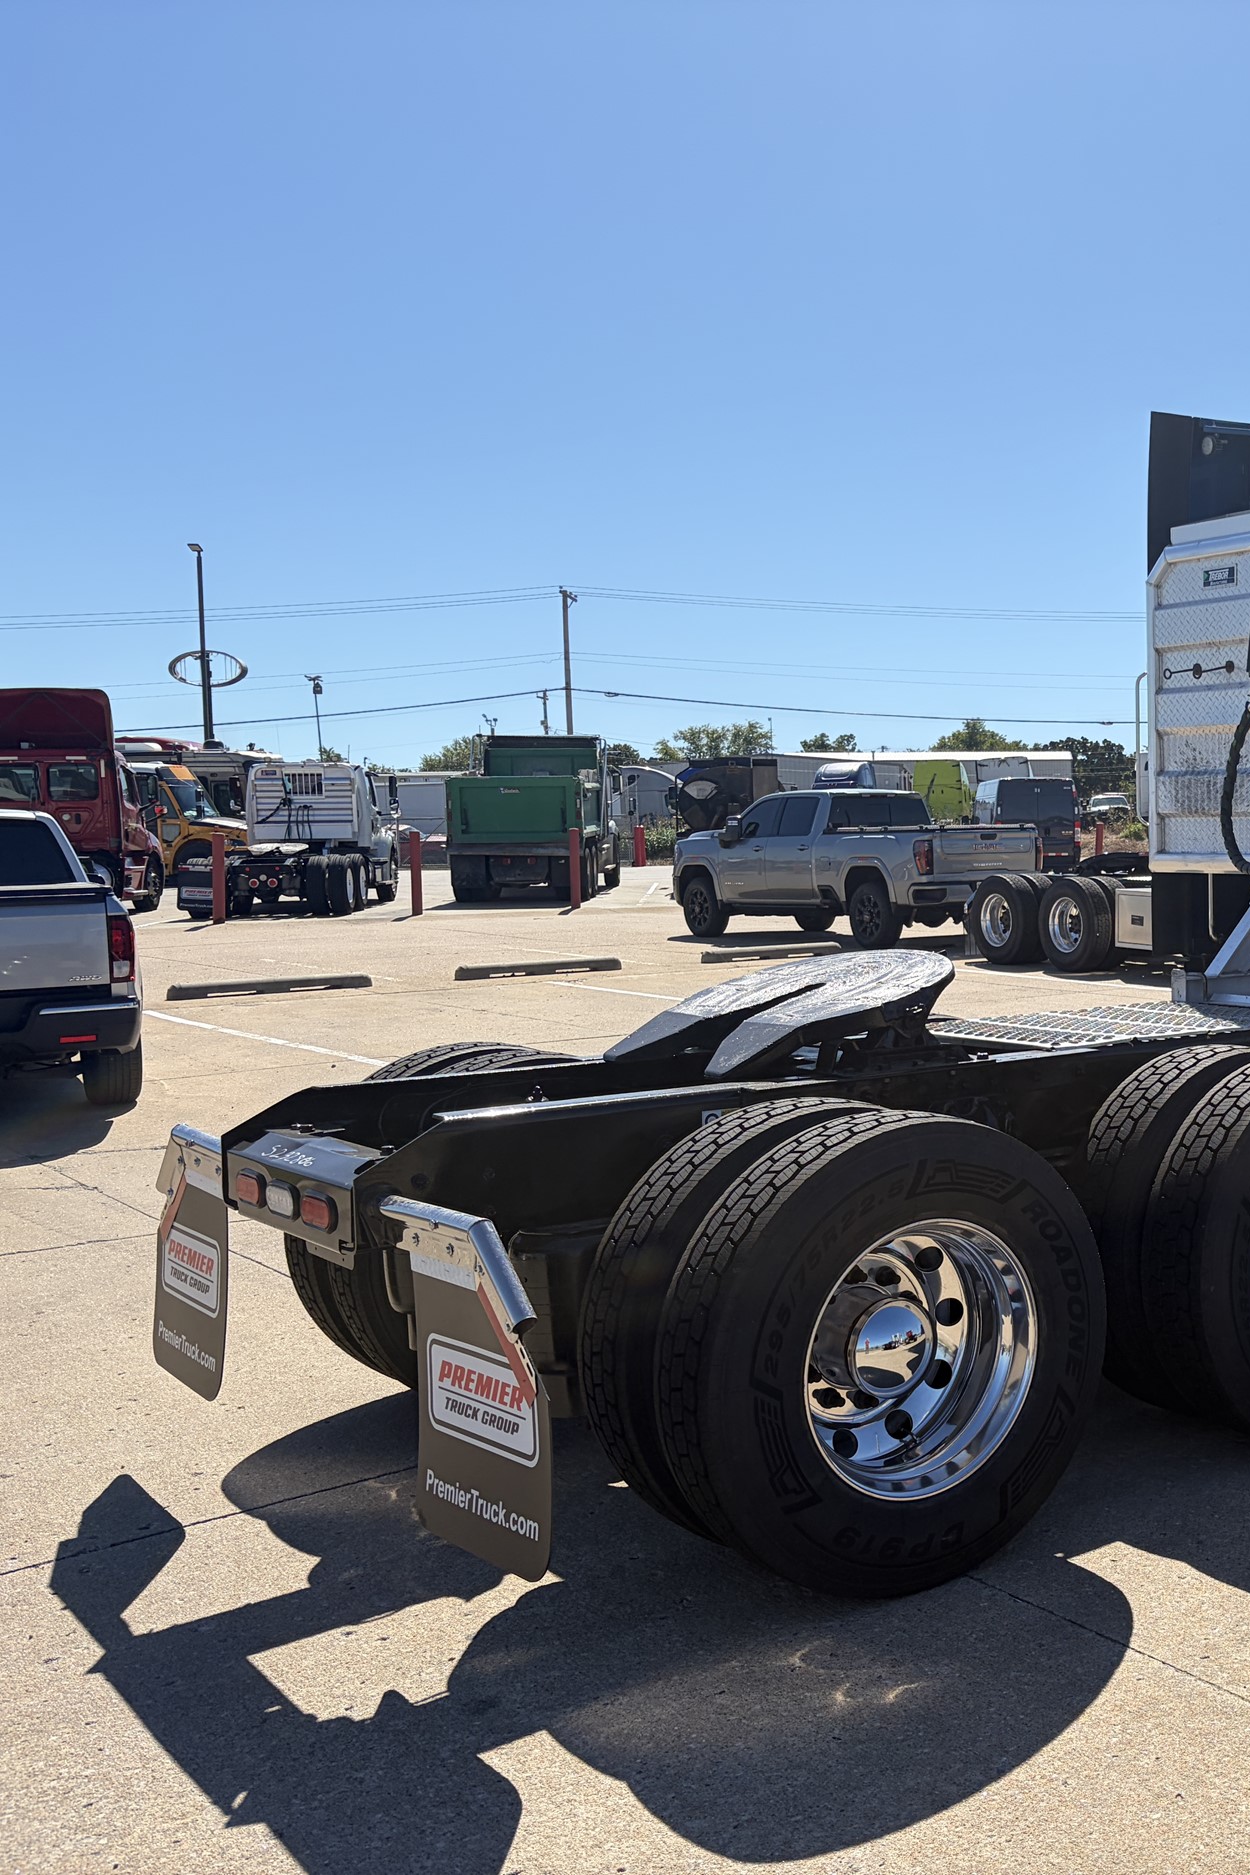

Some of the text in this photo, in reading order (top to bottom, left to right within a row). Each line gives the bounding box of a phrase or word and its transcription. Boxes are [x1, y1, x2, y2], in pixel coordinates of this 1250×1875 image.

[167, 1238, 215, 1278] PREMIER
[170, 1265, 210, 1295] TRUCK GROUP
[1021, 1192, 1087, 1377] ROADONE
[158, 1320, 216, 1372] PremierTruck.com
[438, 1360, 524, 1412] PREMIER
[444, 1396, 520, 1436] TRUCK GROUP
[425, 1468, 539, 1541] PremierTruck.com
